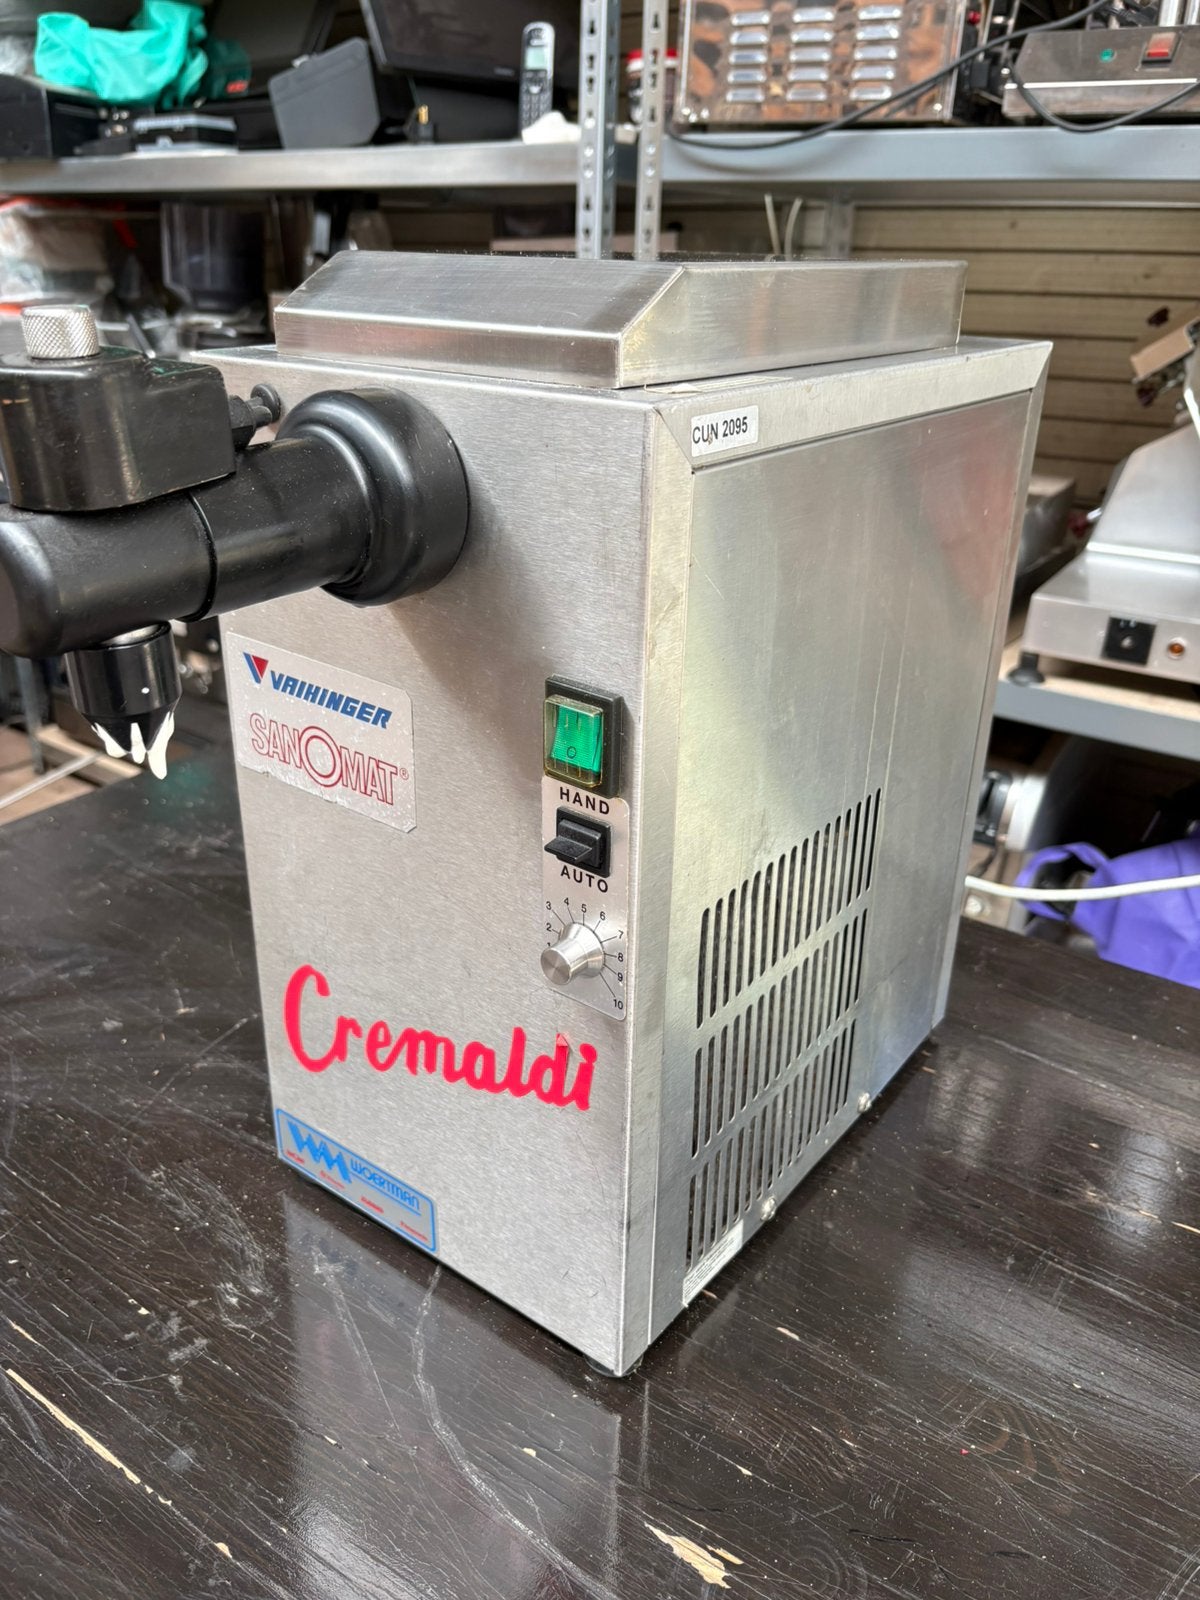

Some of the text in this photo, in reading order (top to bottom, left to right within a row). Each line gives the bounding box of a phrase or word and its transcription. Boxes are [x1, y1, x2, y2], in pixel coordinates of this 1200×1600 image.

[692, 416, 748, 444] CUN 2095
[270, 670, 393, 730] VAIHINGER
[559, 786, 610, 815] HAND
[560, 864, 609, 893] AUTO
[545, 901, 552, 910] 3
[563, 897, 570, 906] 4
[581, 903, 587, 913] 5
[600, 911, 606, 921] 6
[546, 922, 552, 932] 2
[617, 929, 624, 939] 7
[617, 952, 624, 962] 8
[617, 972, 623, 982] 9
[613, 999, 624, 1010] 10
[283, 964, 598, 1111] Cremaldi
